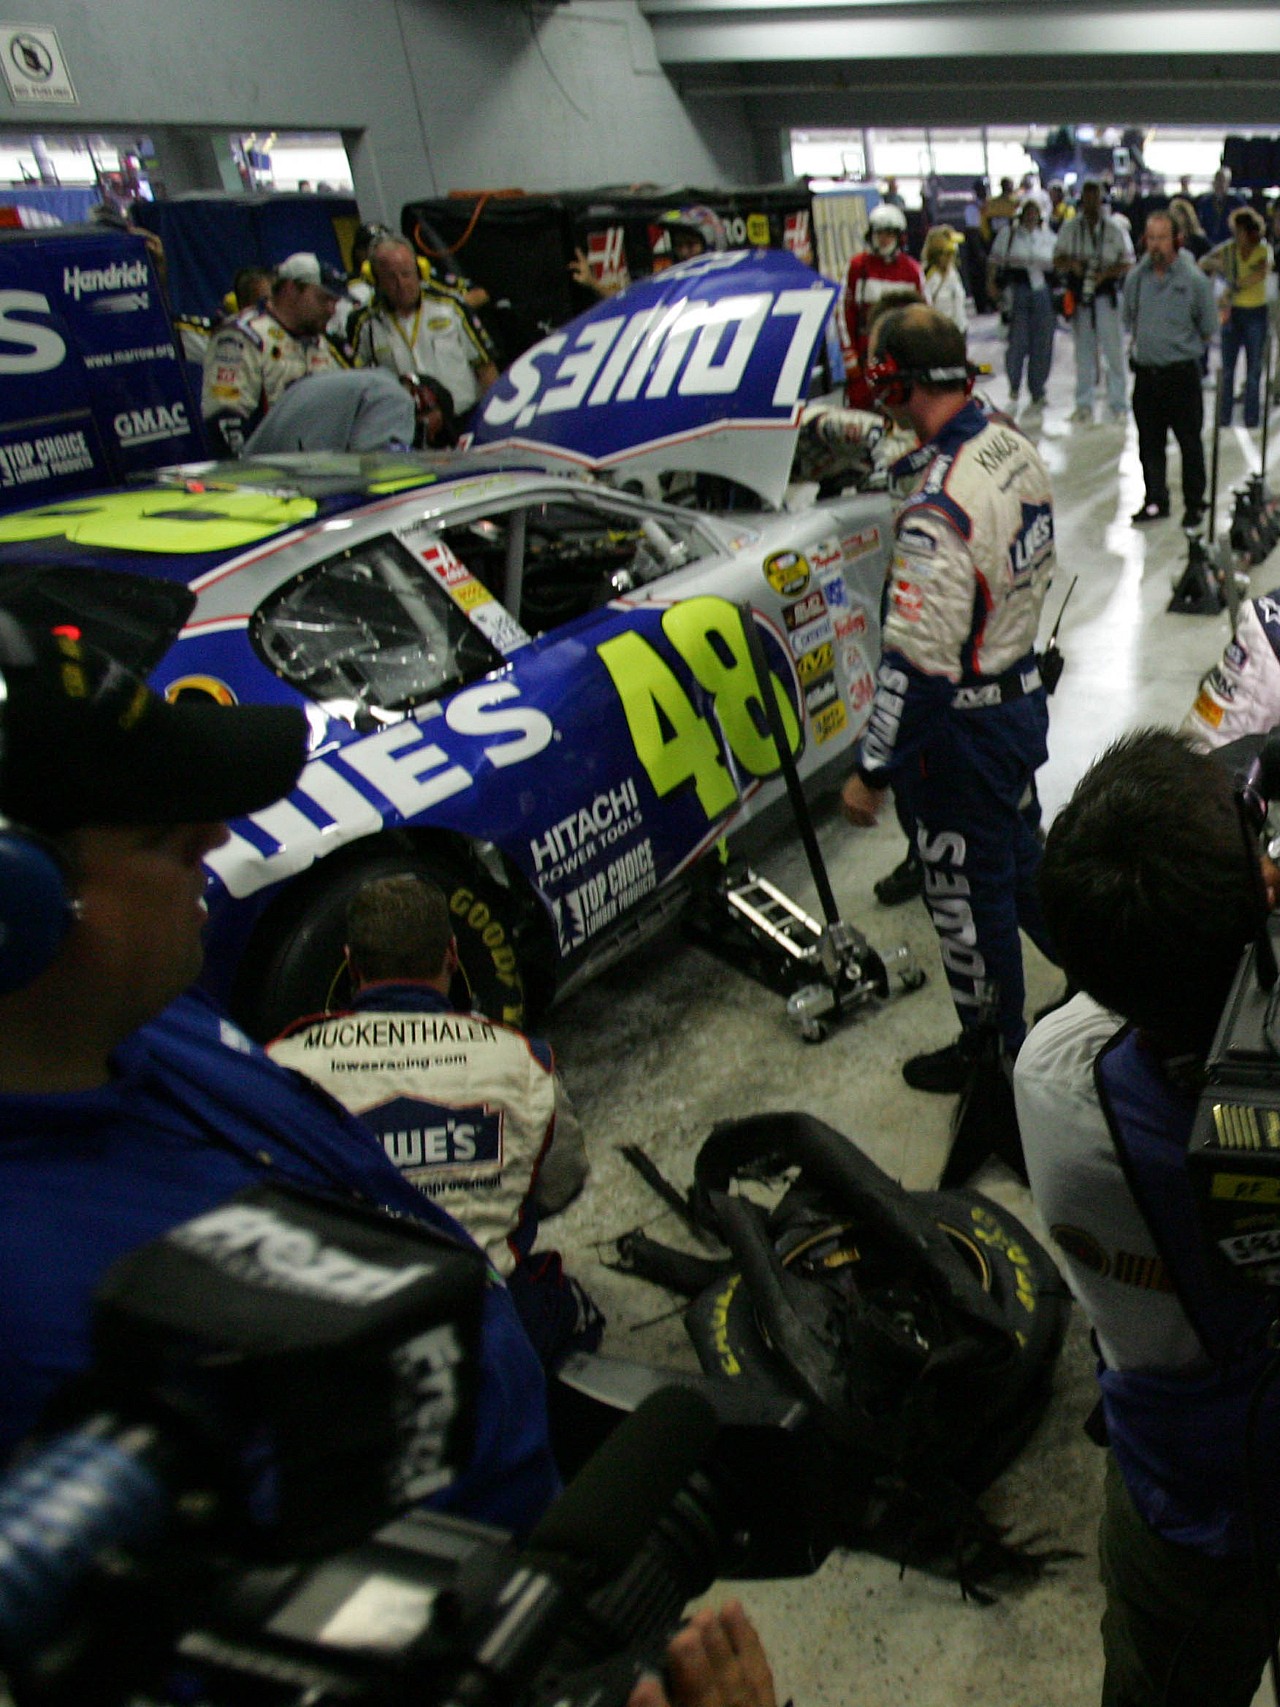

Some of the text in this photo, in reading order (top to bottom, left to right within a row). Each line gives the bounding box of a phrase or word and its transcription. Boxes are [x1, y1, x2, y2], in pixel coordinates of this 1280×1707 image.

[483, 288, 836, 430] LOWE'S
[35, 431, 88, 465] CHOICE
[113, 402, 186, 438] GMAC
[596, 595, 801, 821] 48
[203, 681, 554, 900] WE'S
[530, 776, 640, 873] HITACHI
[538, 809, 643, 891] POWER TOOLS
[578, 837, 655, 918] TOP CHOICE
[330, 1052, 468, 1073] lowesracing.com
[378, 1118, 477, 1167] WE'S
